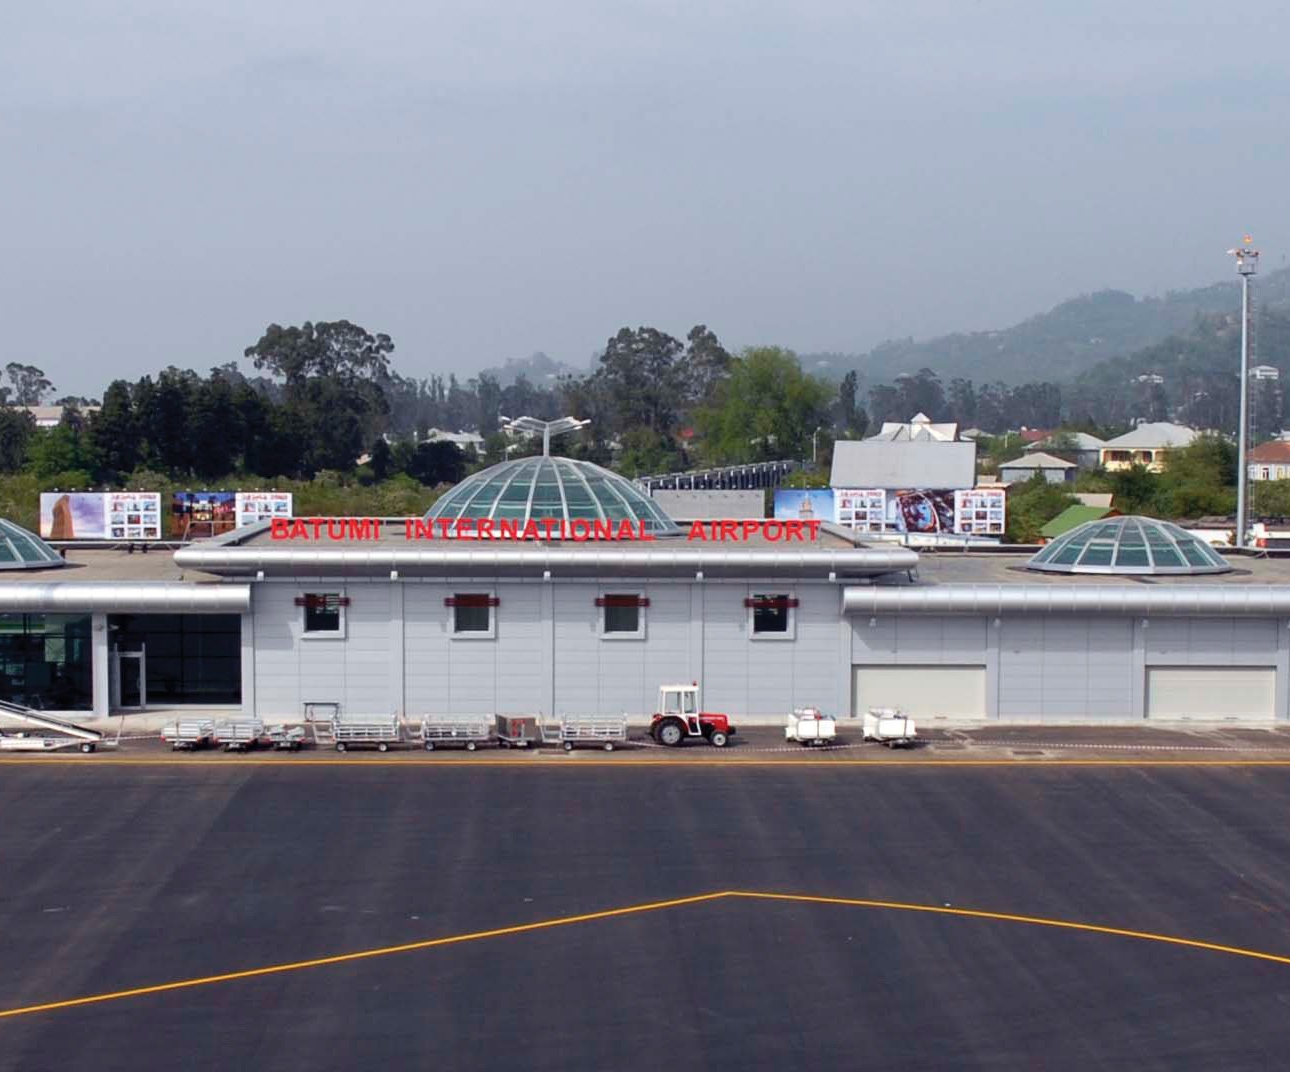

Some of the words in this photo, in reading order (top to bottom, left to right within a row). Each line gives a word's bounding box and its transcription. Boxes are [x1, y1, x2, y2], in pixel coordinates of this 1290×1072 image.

[270, 517, 381, 542] BATUMI
[404, 517, 656, 542] INTERNATIONAL
[687, 518, 822, 543] AIRPORT
